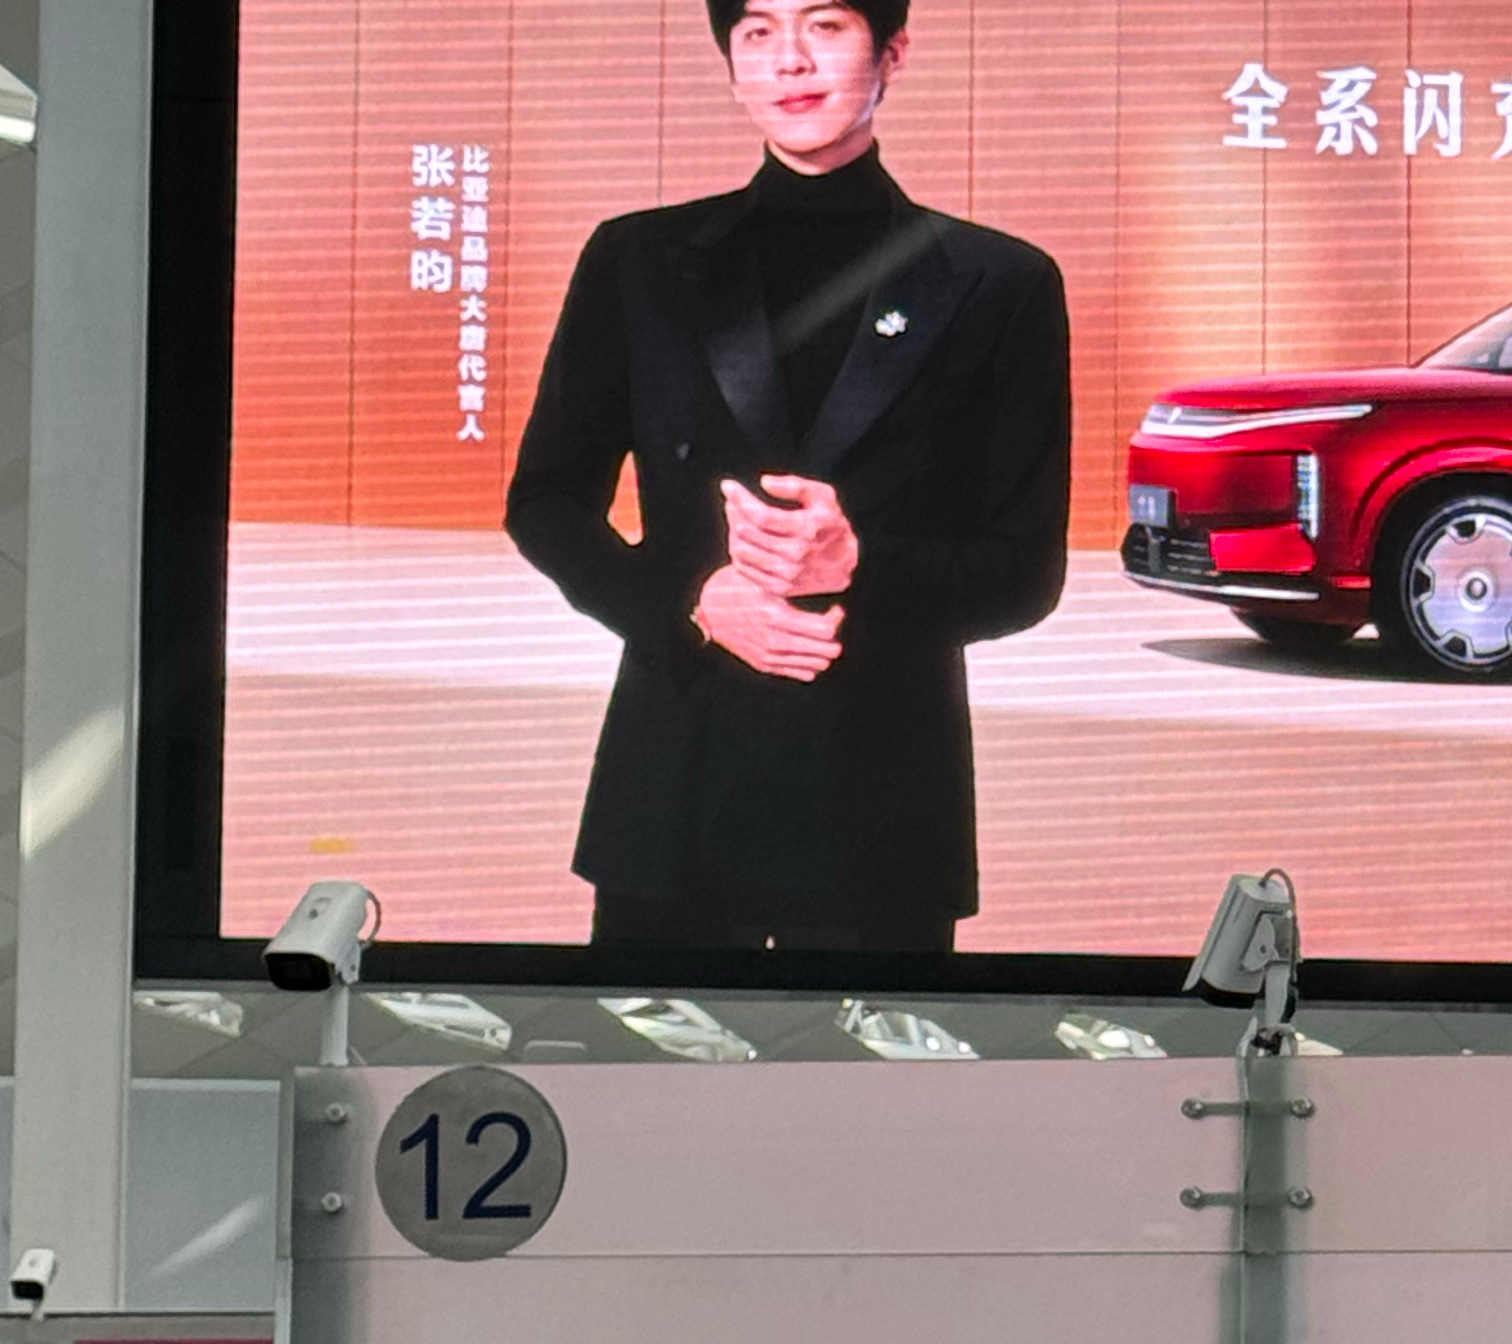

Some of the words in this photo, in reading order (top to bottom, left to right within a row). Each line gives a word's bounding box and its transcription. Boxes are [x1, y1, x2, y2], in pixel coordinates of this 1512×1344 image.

[410, 143, 456, 294] 张若昀
[456, 145, 490, 443] 比亚迪品牌大唐代言人
[400, 1112, 532, 1220] 12
